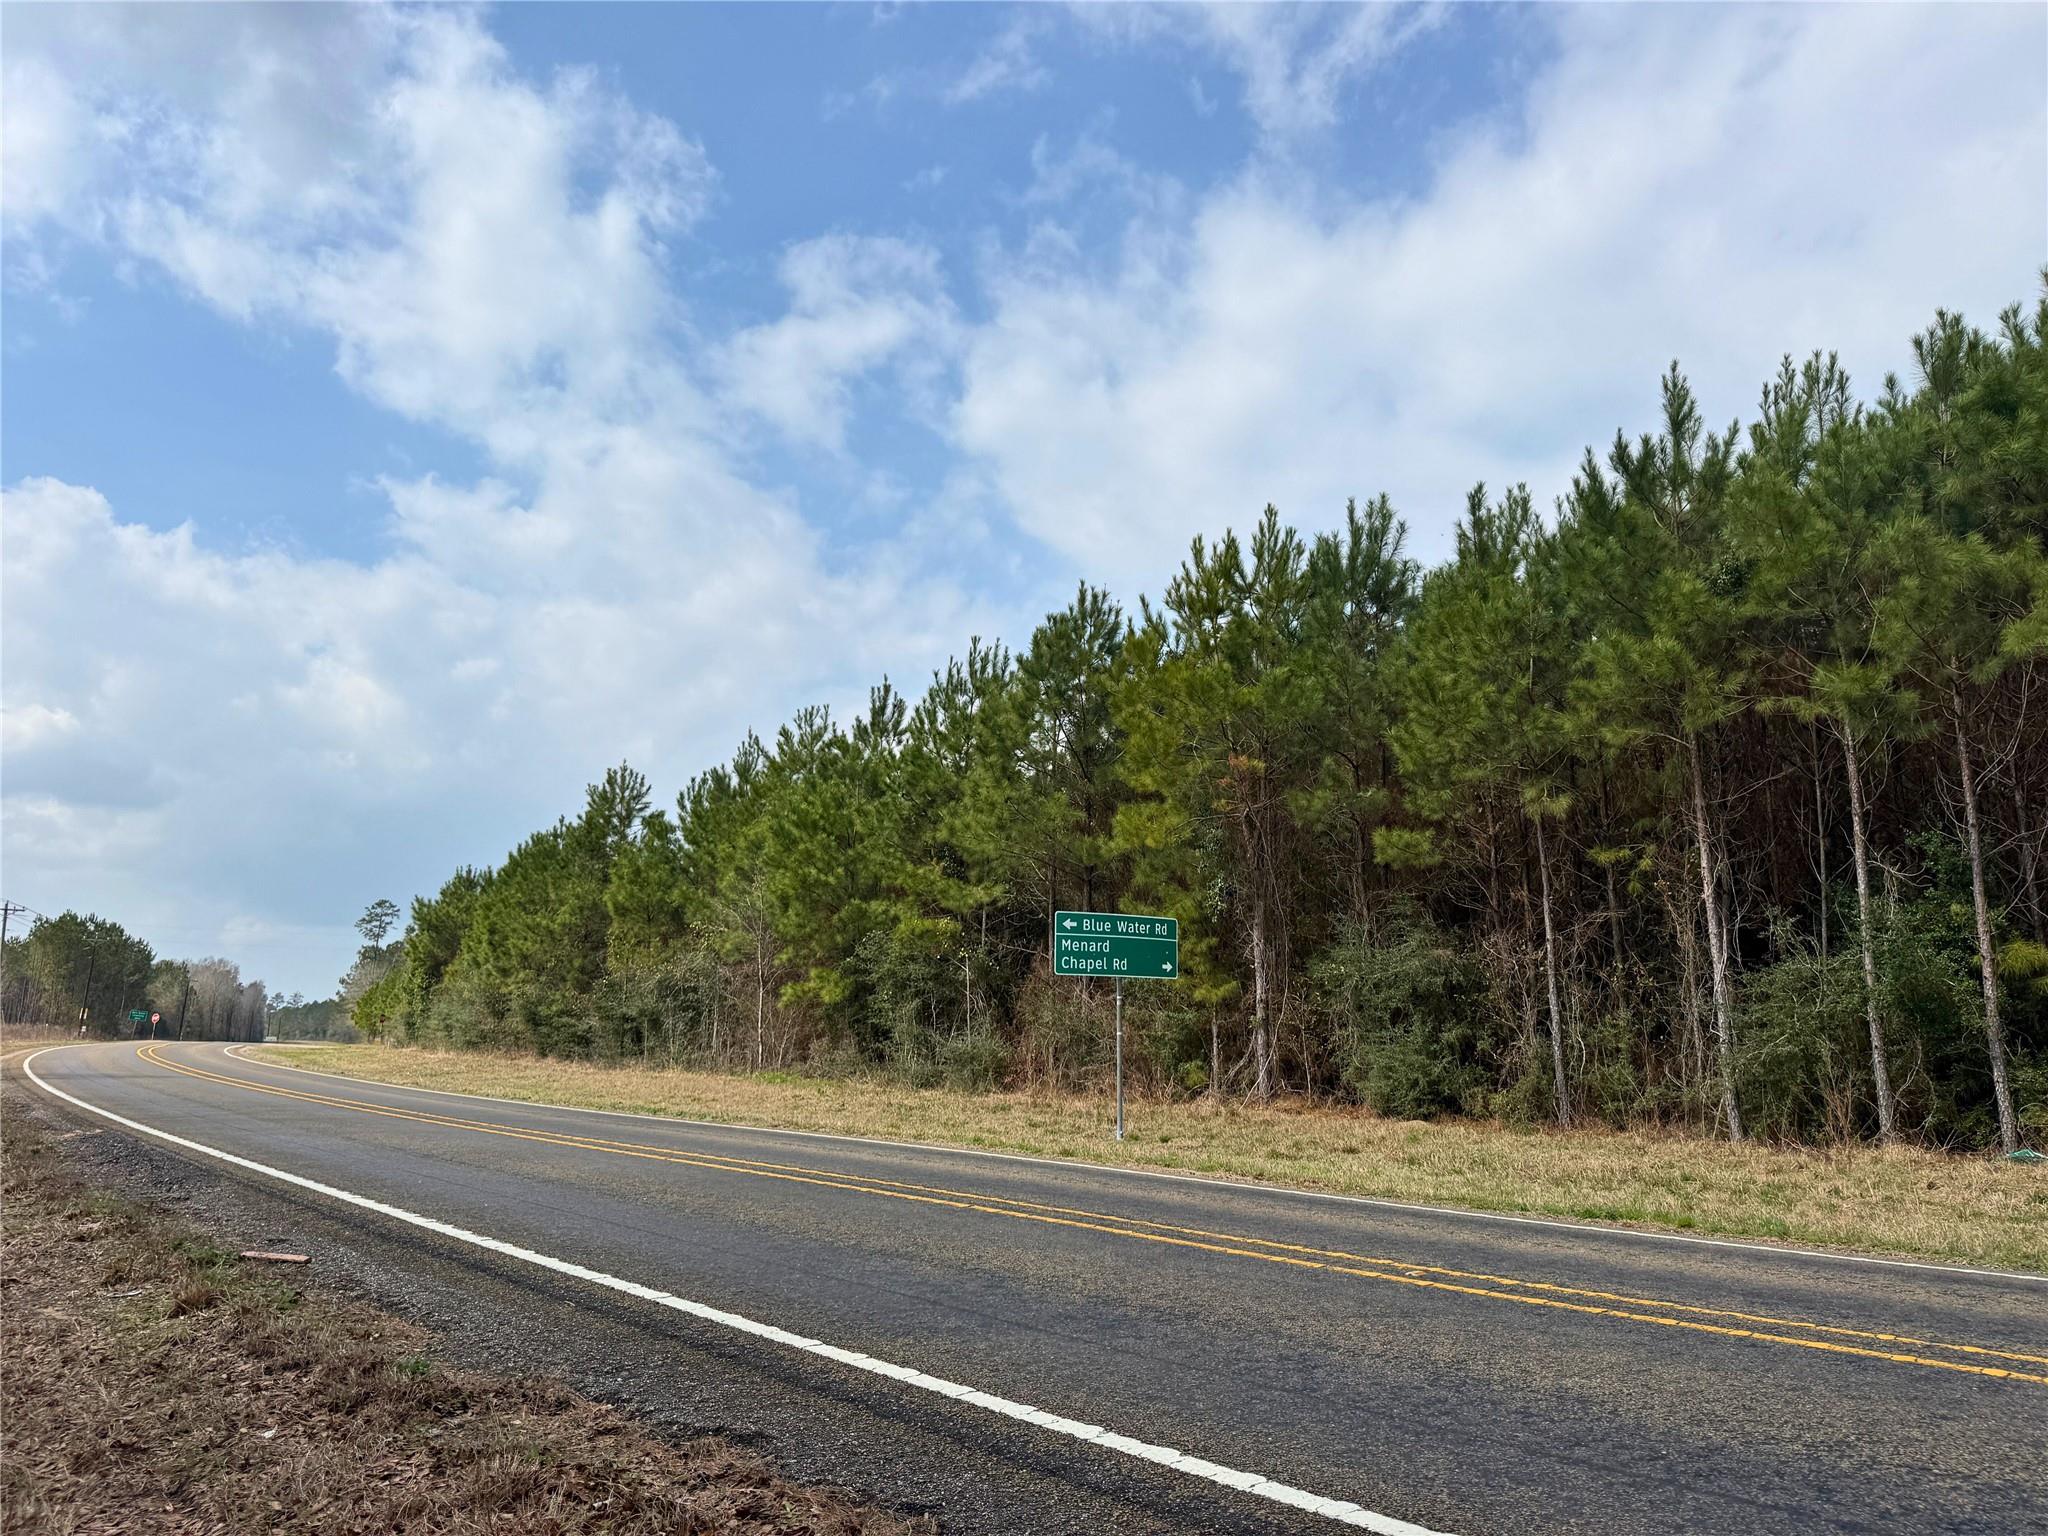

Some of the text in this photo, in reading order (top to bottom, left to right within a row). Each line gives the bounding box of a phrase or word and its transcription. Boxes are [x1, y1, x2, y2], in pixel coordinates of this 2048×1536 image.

[1083, 919, 1167, 935] Blue Water Rd
[1061, 939, 1110, 952] Menard
[1061, 956, 1127, 972] Chapel Rd
